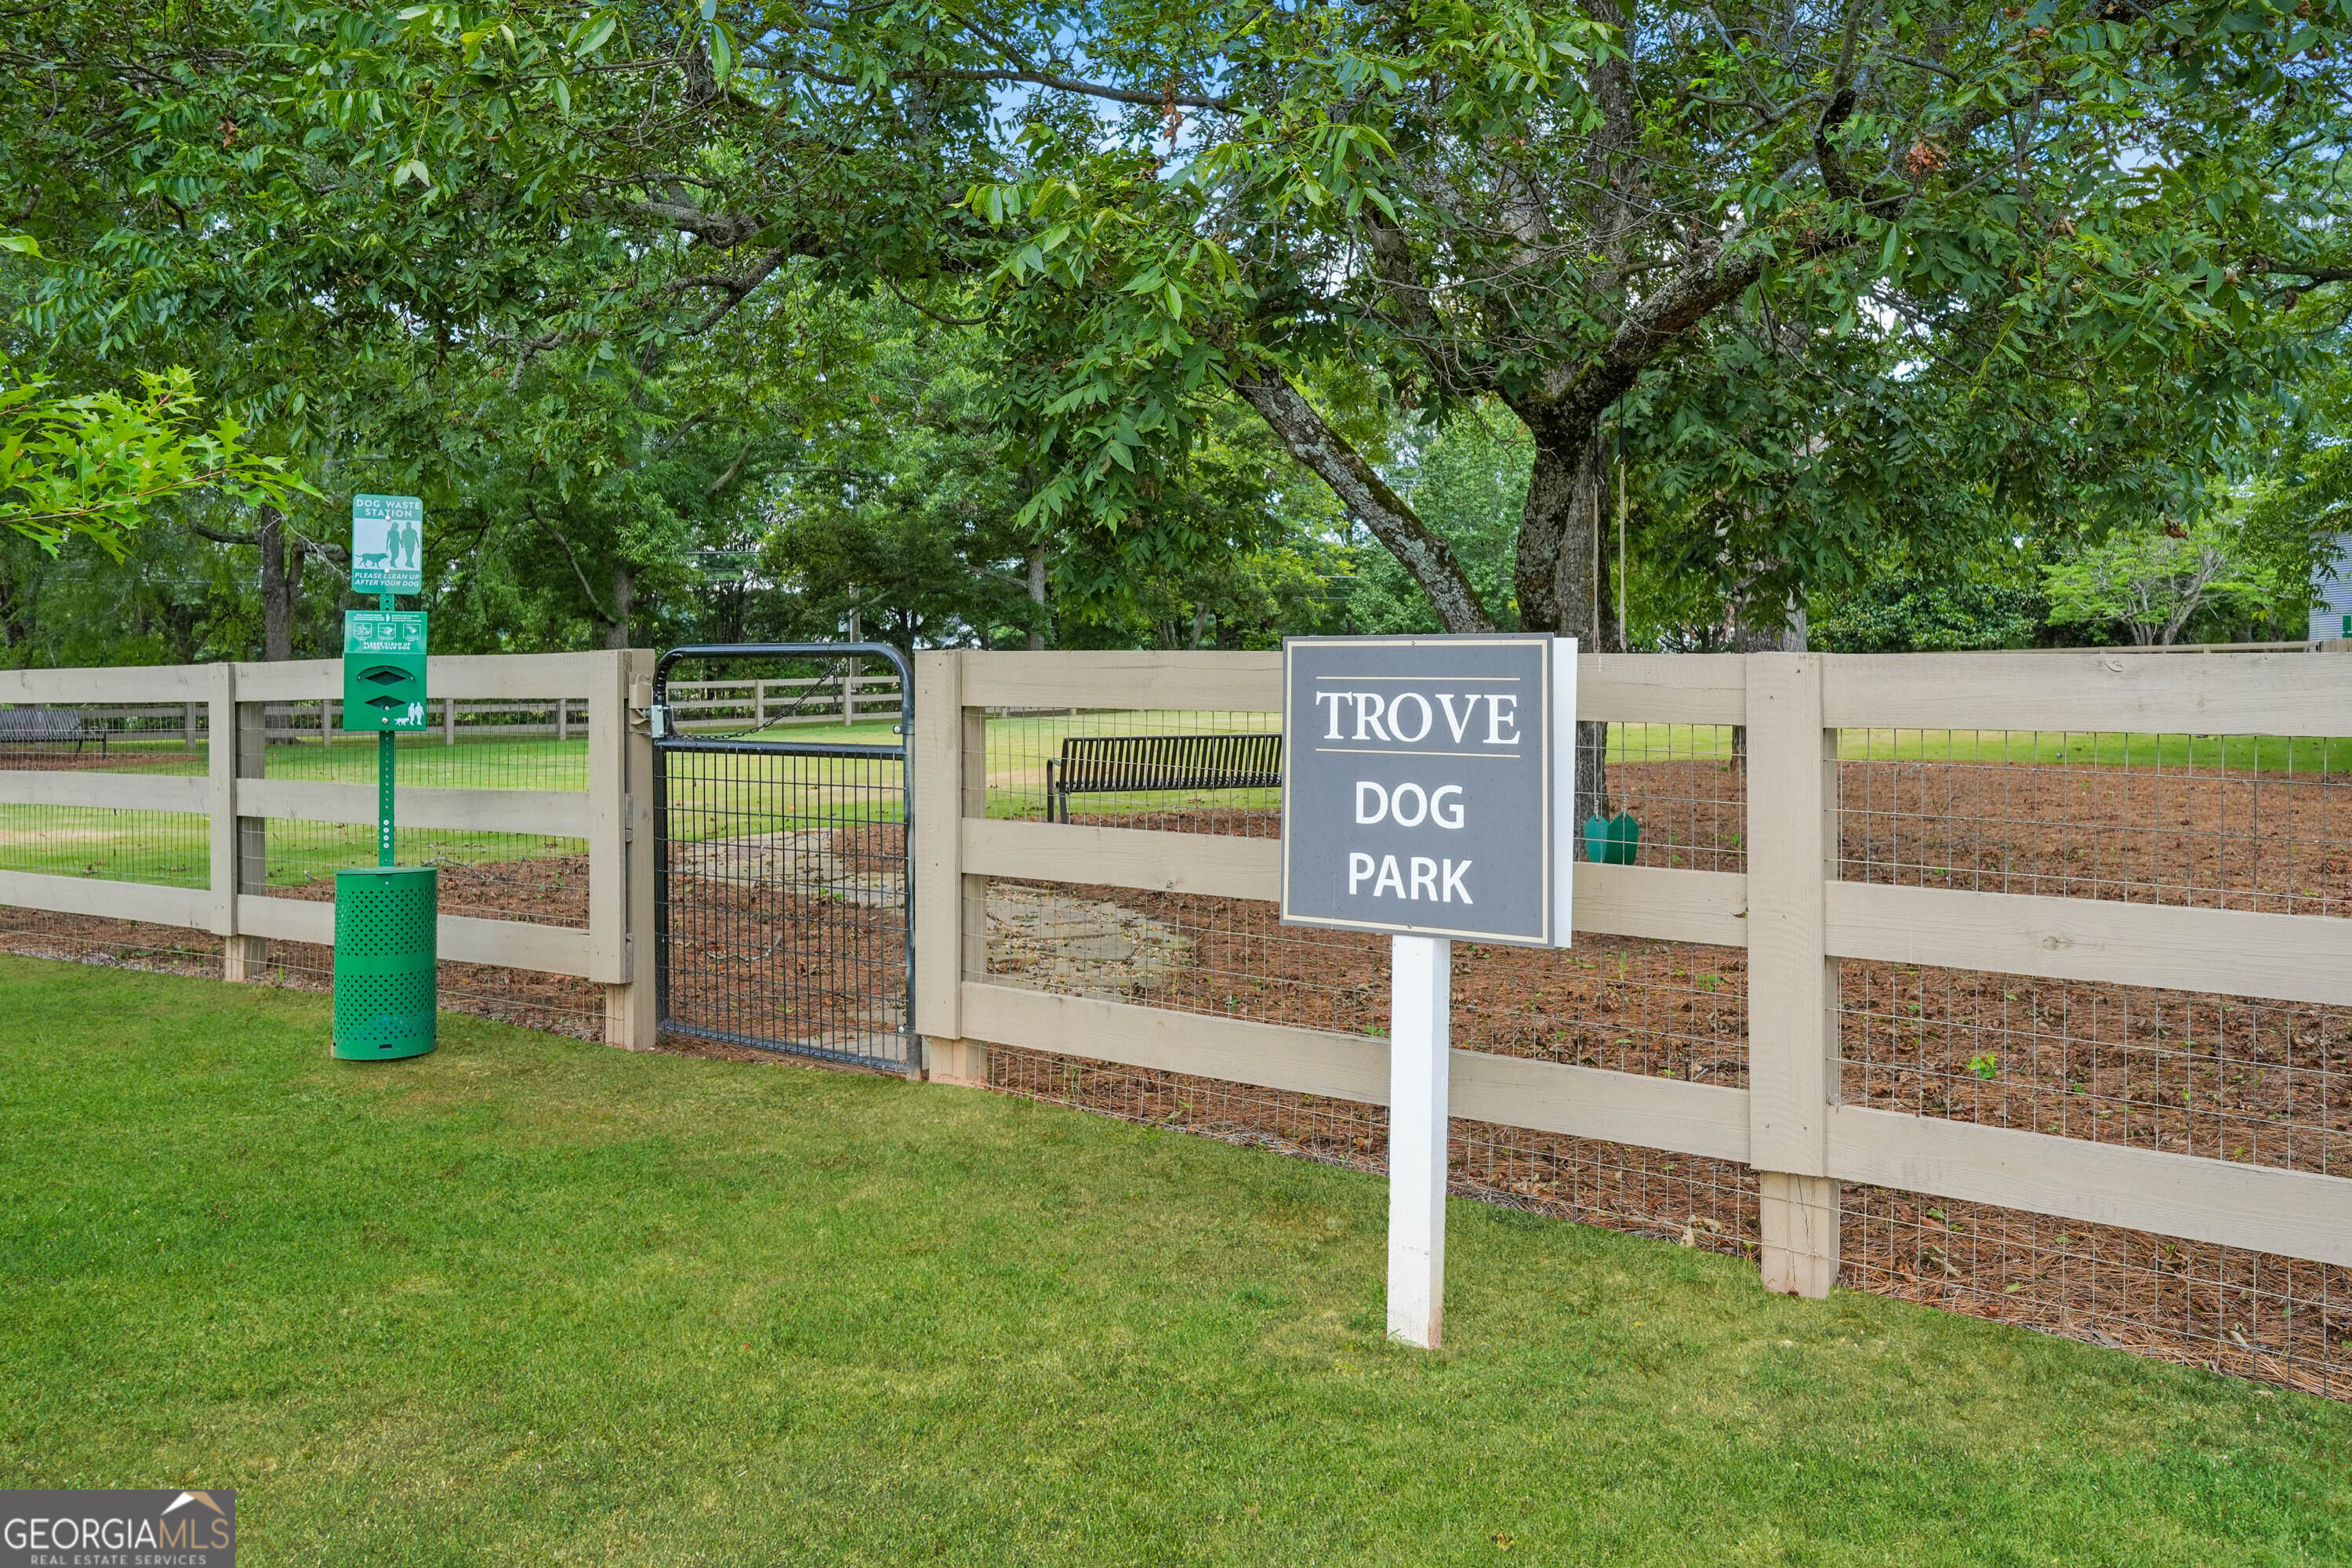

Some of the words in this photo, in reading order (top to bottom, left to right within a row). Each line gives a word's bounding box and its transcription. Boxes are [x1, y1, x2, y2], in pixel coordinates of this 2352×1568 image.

[356, 499, 380, 508] DOG
[386, 501, 421, 510] WASTE
[365, 509, 412, 517] STATION
[1316, 691, 1521, 745] TROVE
[1356, 781, 1465, 829] DOG
[1348, 852, 1474, 905] PARK
